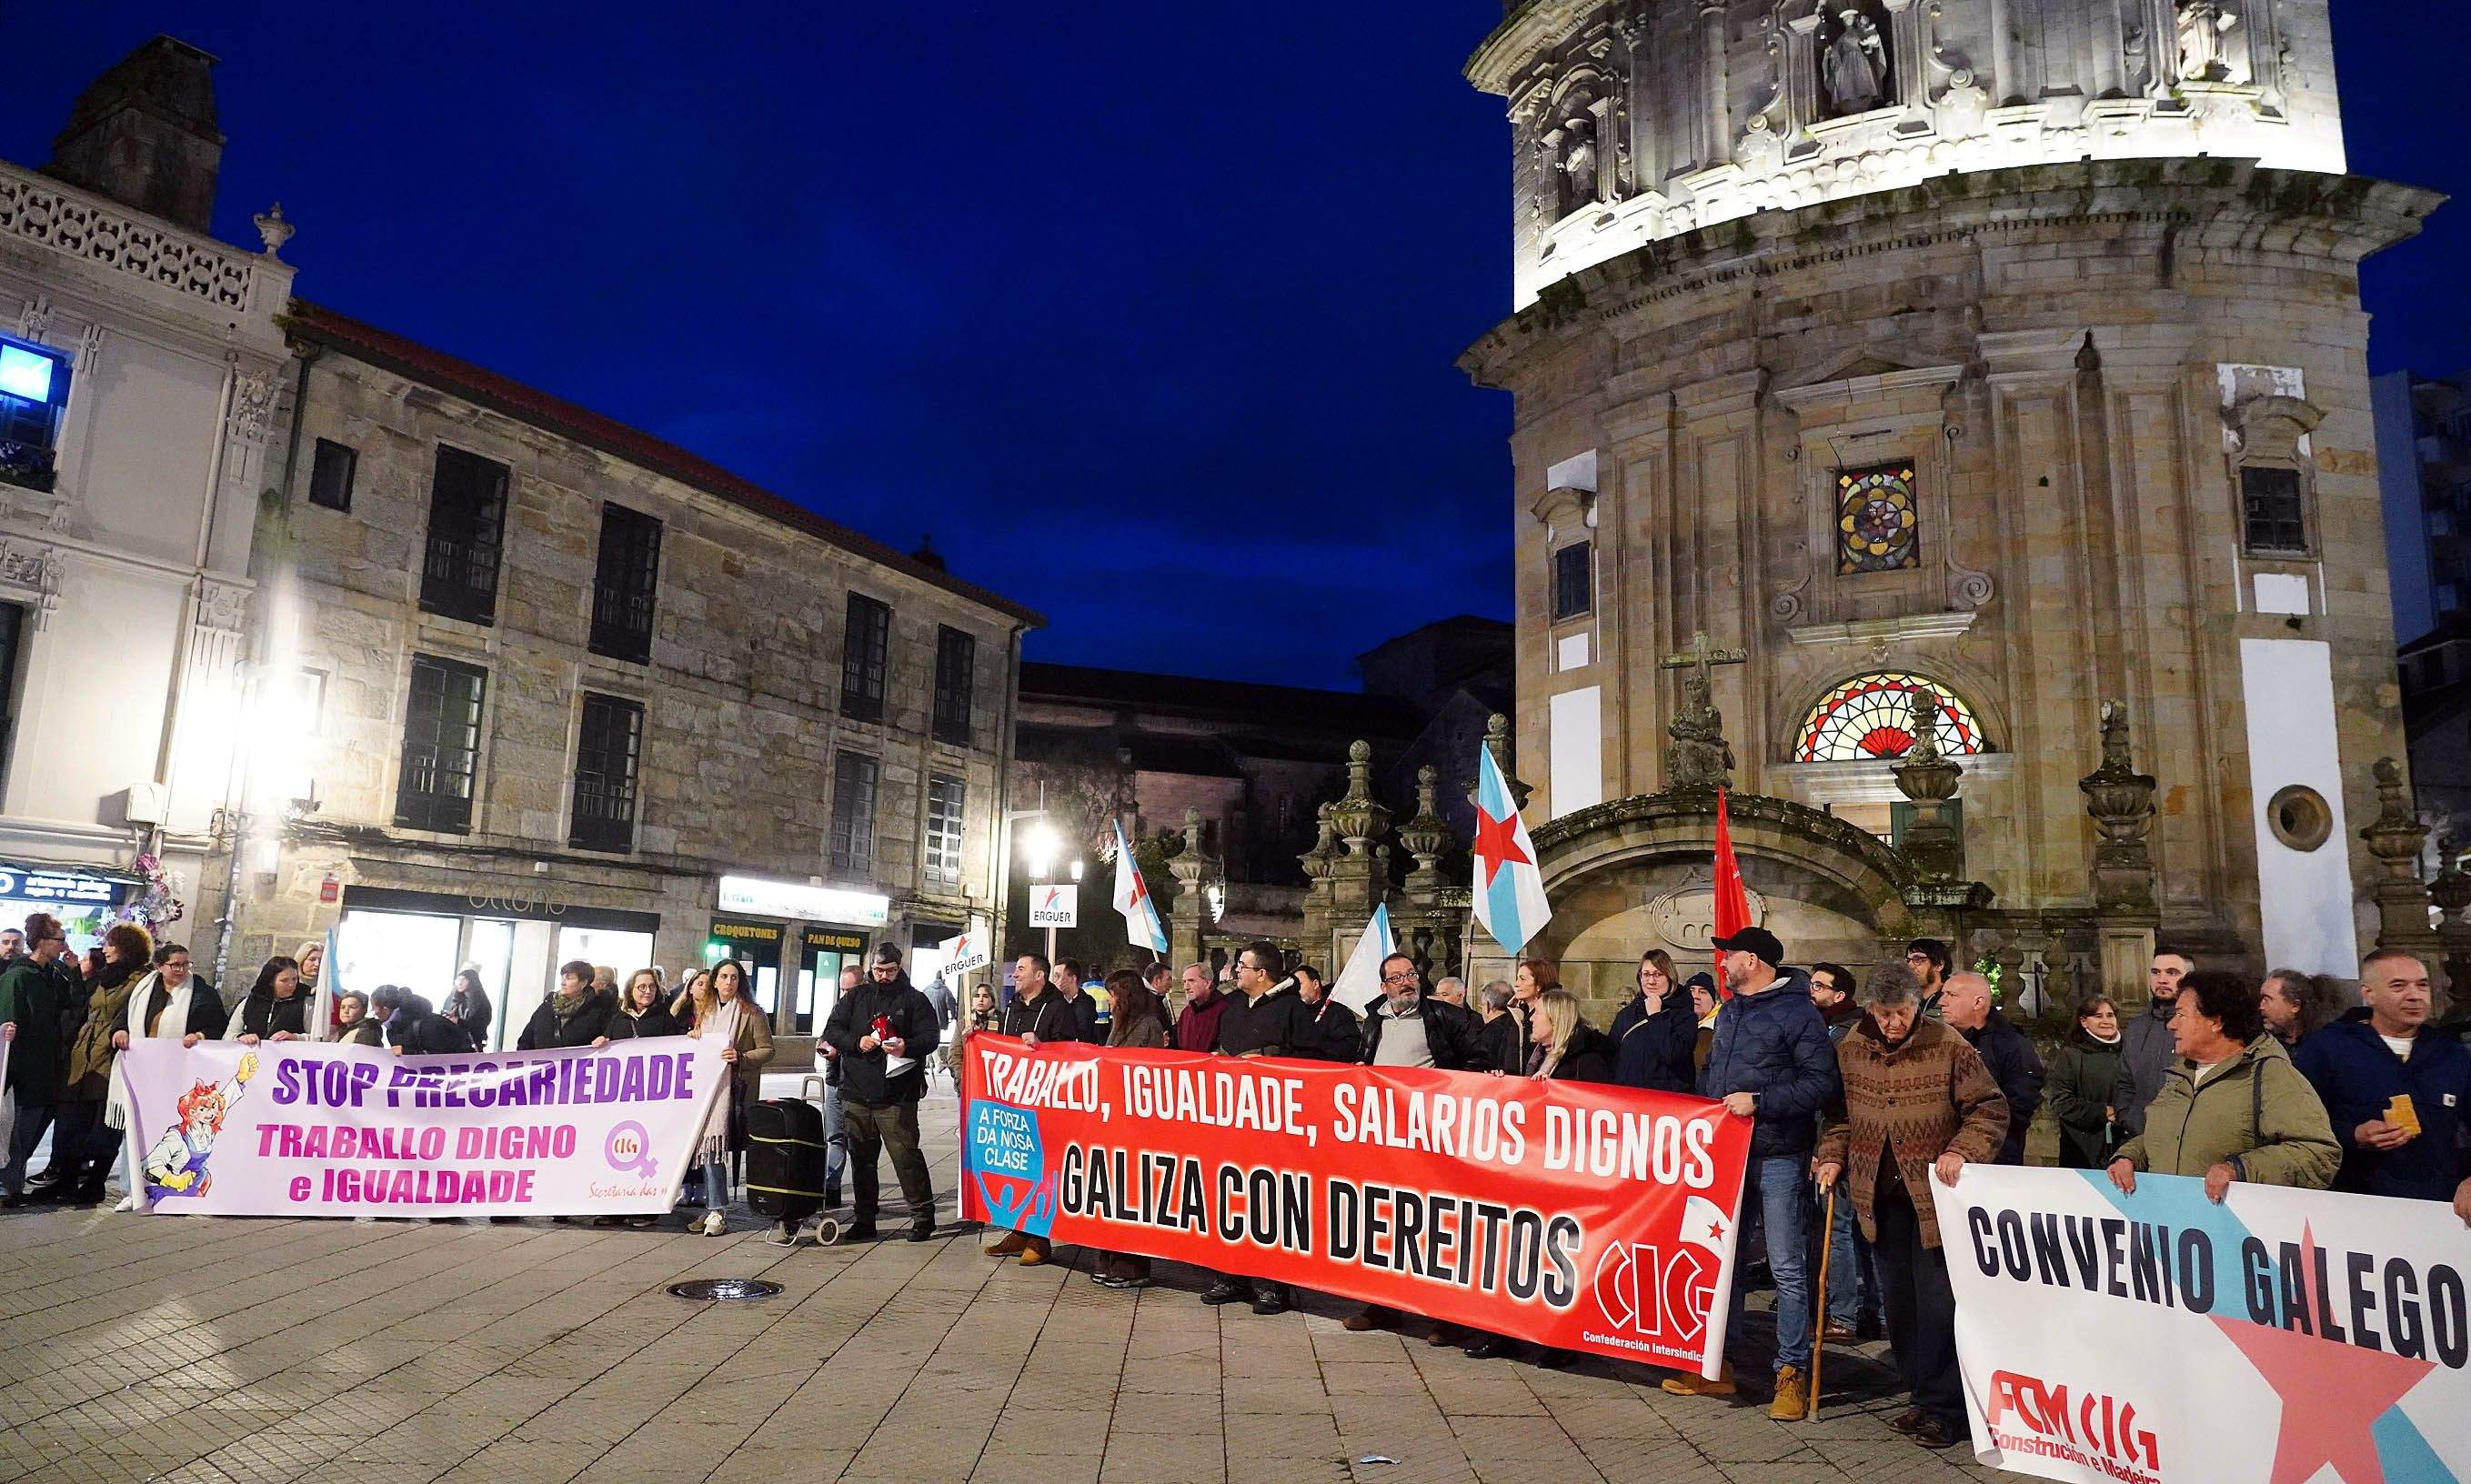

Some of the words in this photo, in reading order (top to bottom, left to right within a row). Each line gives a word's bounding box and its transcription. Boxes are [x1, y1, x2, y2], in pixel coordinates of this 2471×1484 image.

[1034, 910, 1071, 923] ERGUER
[714, 923, 778, 940] CROQUETONES
[808, 934, 823, 945] PAN
[945, 954, 983, 975] ERGUER
[273, 1058, 378, 1108] STOP
[387, 1053, 693, 1108] PRECARIEDADE
[979, 1108, 989, 1125] A
[993, 1108, 1030, 1132] FORZA
[981, 1049, 1110, 1123] TRABALLO,
[1123, 1065, 1317, 1148] IGUALDADE,
[1334, 1083, 1526, 1167] SALARIOS
[1543, 1105, 1714, 1189] DIGNOS
[256, 1124, 446, 1161] TRABALLO
[456, 1124, 576, 1160] DIGNO
[977, 1127, 997, 1146] DA
[1000, 1130, 1035, 1152] NOSA
[984, 1147, 1029, 1171] CLASE
[289, 1176, 311, 1202] e
[321, 1168, 535, 1204] IGUALDADE
[1061, 1143, 1209, 1235] GALIZA
[1218, 1164, 1311, 1254] CON
[1329, 1178, 1582, 1309] DEREITOS
[1594, 1239, 1715, 1342] CIG
[1967, 1206, 2215, 1315] CONVENIO
[2241, 1236, 2469, 1369] GALEGO
[1582, 1330, 1650, 1353] Confederación
[2081, 1392, 2160, 1471] CIG
[2092, 1456, 2102, 1472] e
